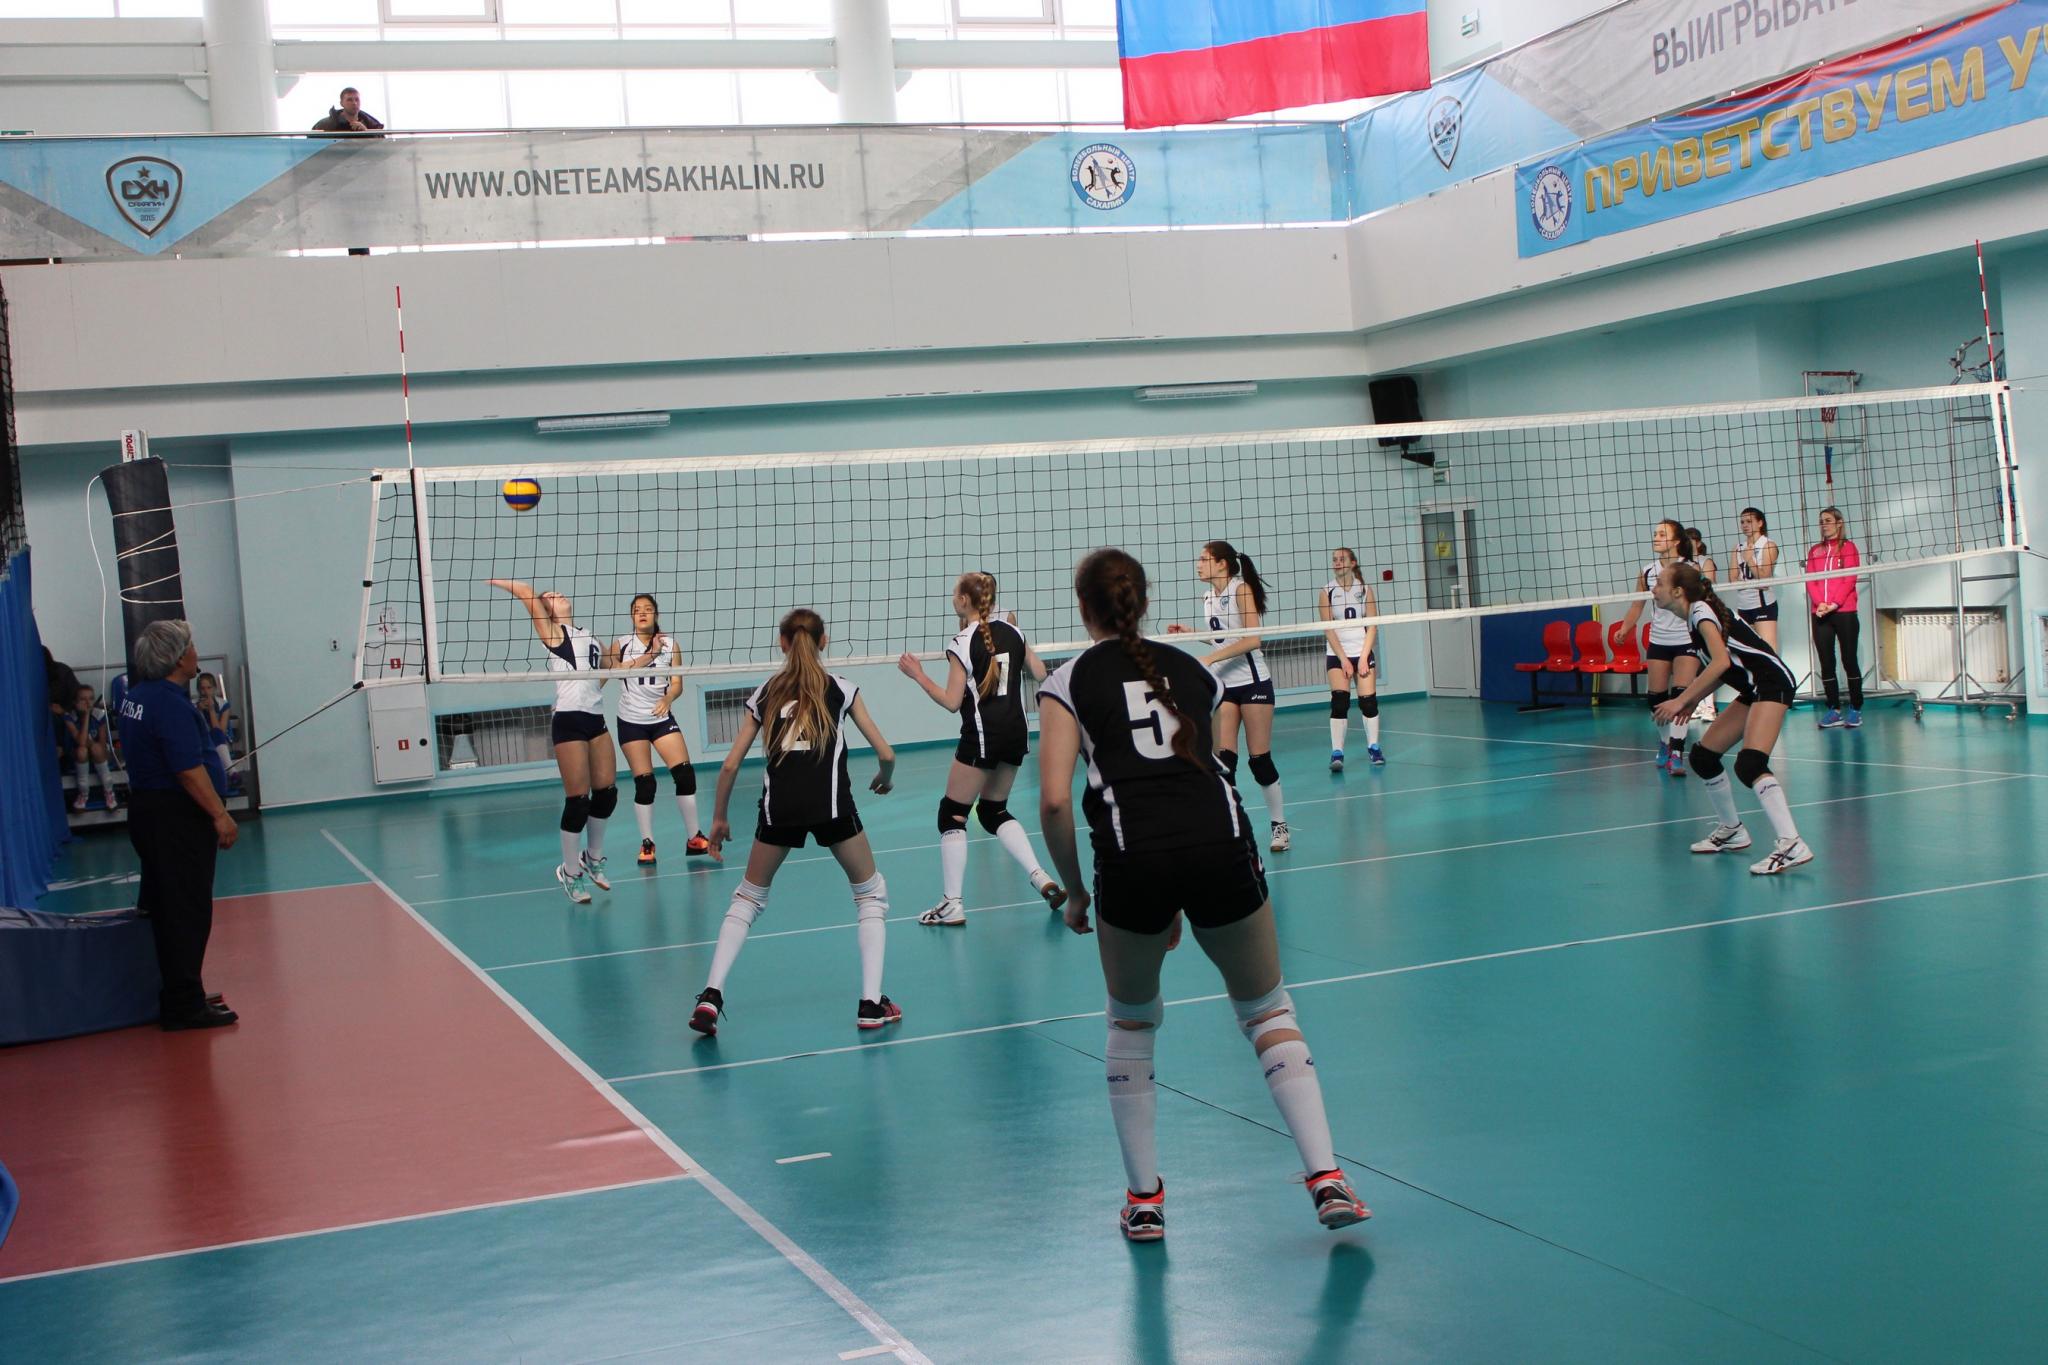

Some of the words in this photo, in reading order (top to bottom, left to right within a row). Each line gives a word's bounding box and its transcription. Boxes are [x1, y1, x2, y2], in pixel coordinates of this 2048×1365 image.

[1653, 0, 1857, 75] ВЫИГРЫВА
[1584, 46, 1986, 214] ПРИВЕТСТВУЕМ
[425, 163, 825, 200] WWW.ONETEAMSAKHALIN.RU
[588, 644, 600, 669] 6
[780, 700, 811, 751] 2
[1122, 677, 1178, 760] 5
